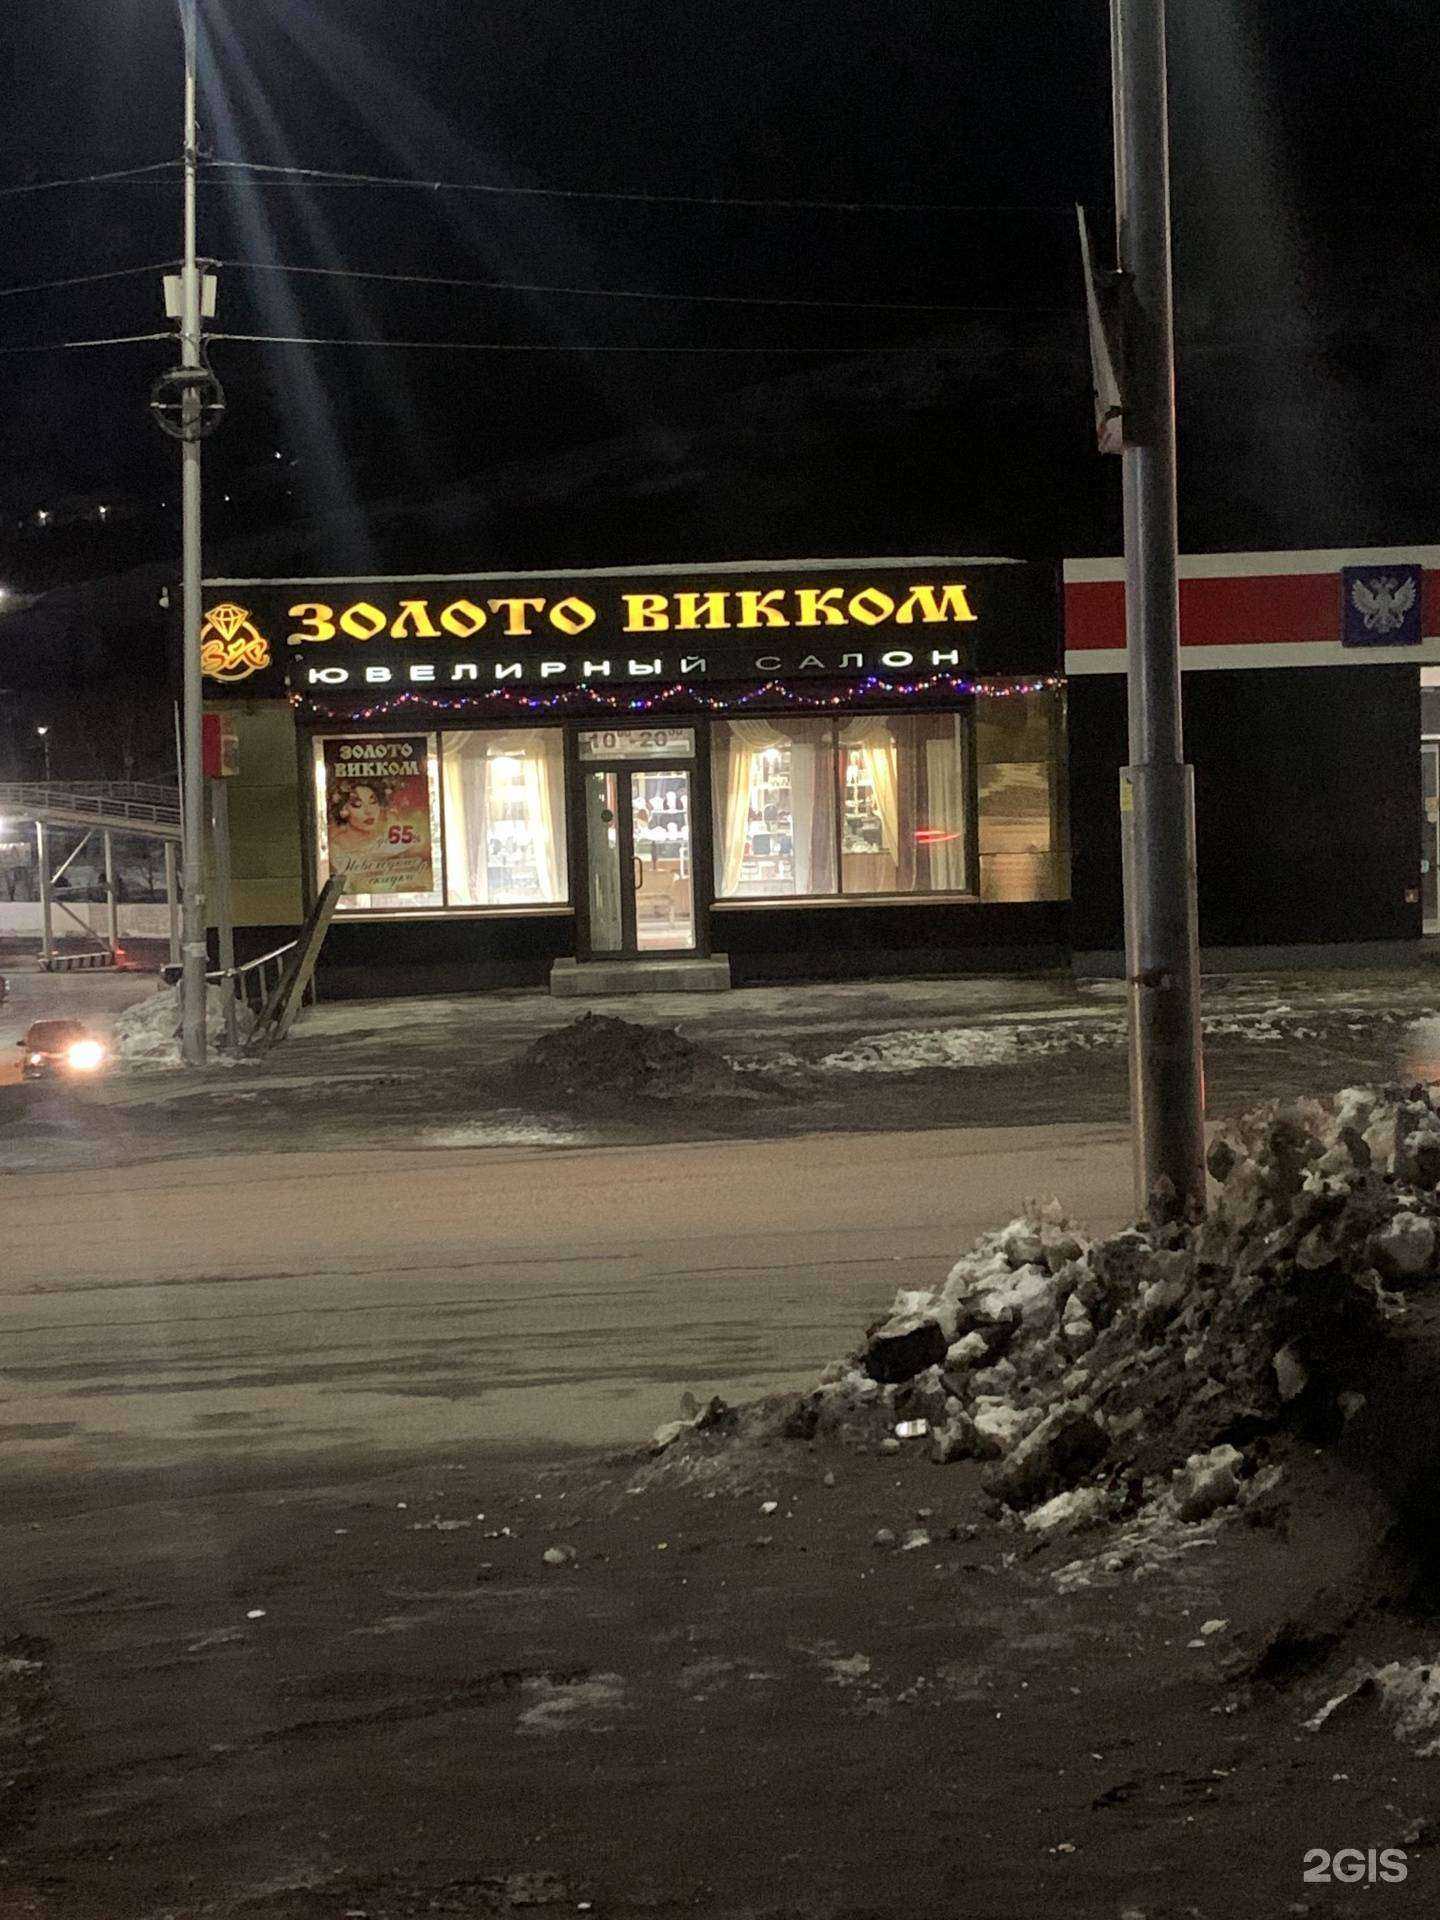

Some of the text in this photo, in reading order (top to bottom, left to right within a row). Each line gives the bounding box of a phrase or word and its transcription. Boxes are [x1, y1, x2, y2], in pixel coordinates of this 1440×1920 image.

[287, 584, 979, 645] ЗОЛОТО ВИККОМ
[308, 649, 960, 684] ЮВЕЛИРНЫЙ САЛОН
[339, 743, 413, 760] ЗОЛОТО
[334, 761, 420, 778] ВИККОМ
